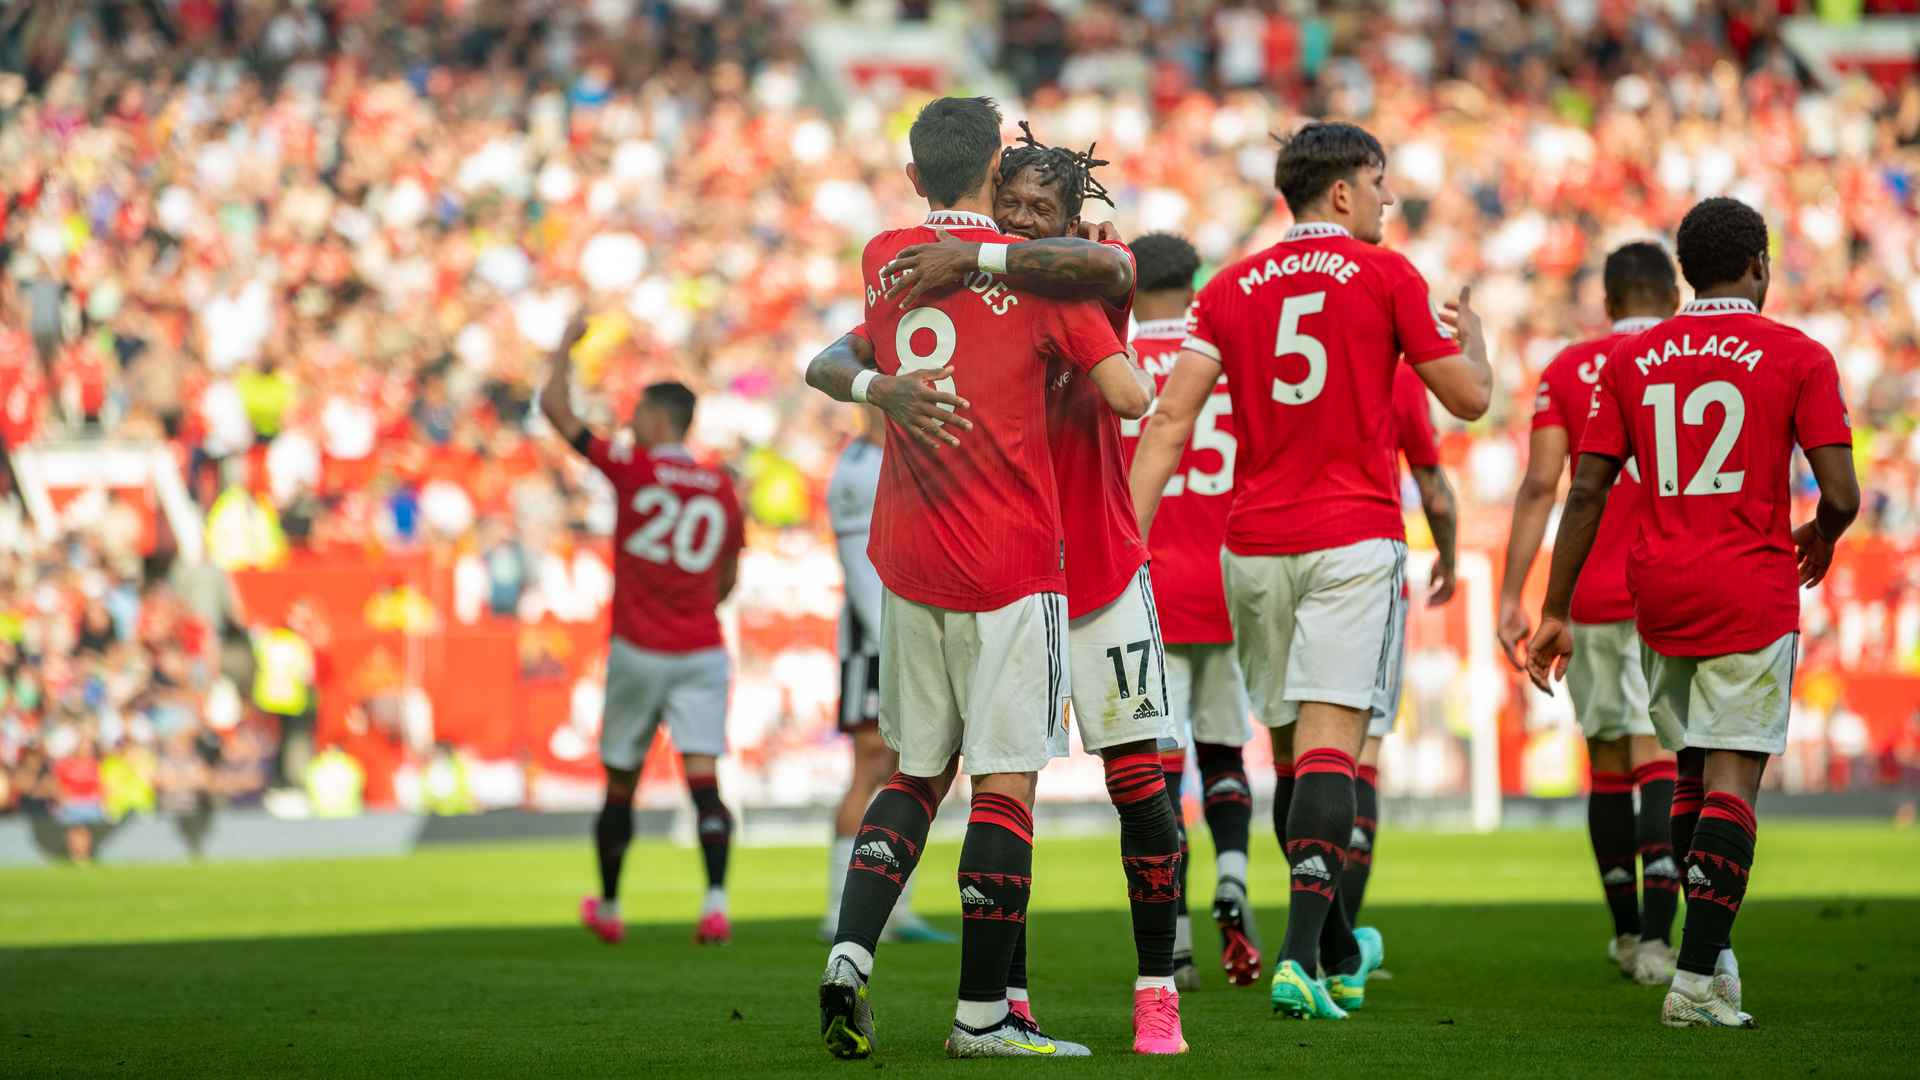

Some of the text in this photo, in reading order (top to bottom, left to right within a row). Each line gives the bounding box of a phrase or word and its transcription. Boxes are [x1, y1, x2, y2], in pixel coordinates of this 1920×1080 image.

[866, 259, 1018, 316] B.FDES
[1237, 251, 1361, 296] MAGUIRE
[1271, 290, 1328, 406] 5
[1634, 334, 1764, 376] MALACIA
[1642, 380, 1745, 497] 12
[624, 485, 727, 573] 20
[1106, 639, 1151, 699] 17
[1133, 710, 1160, 720] adidas
